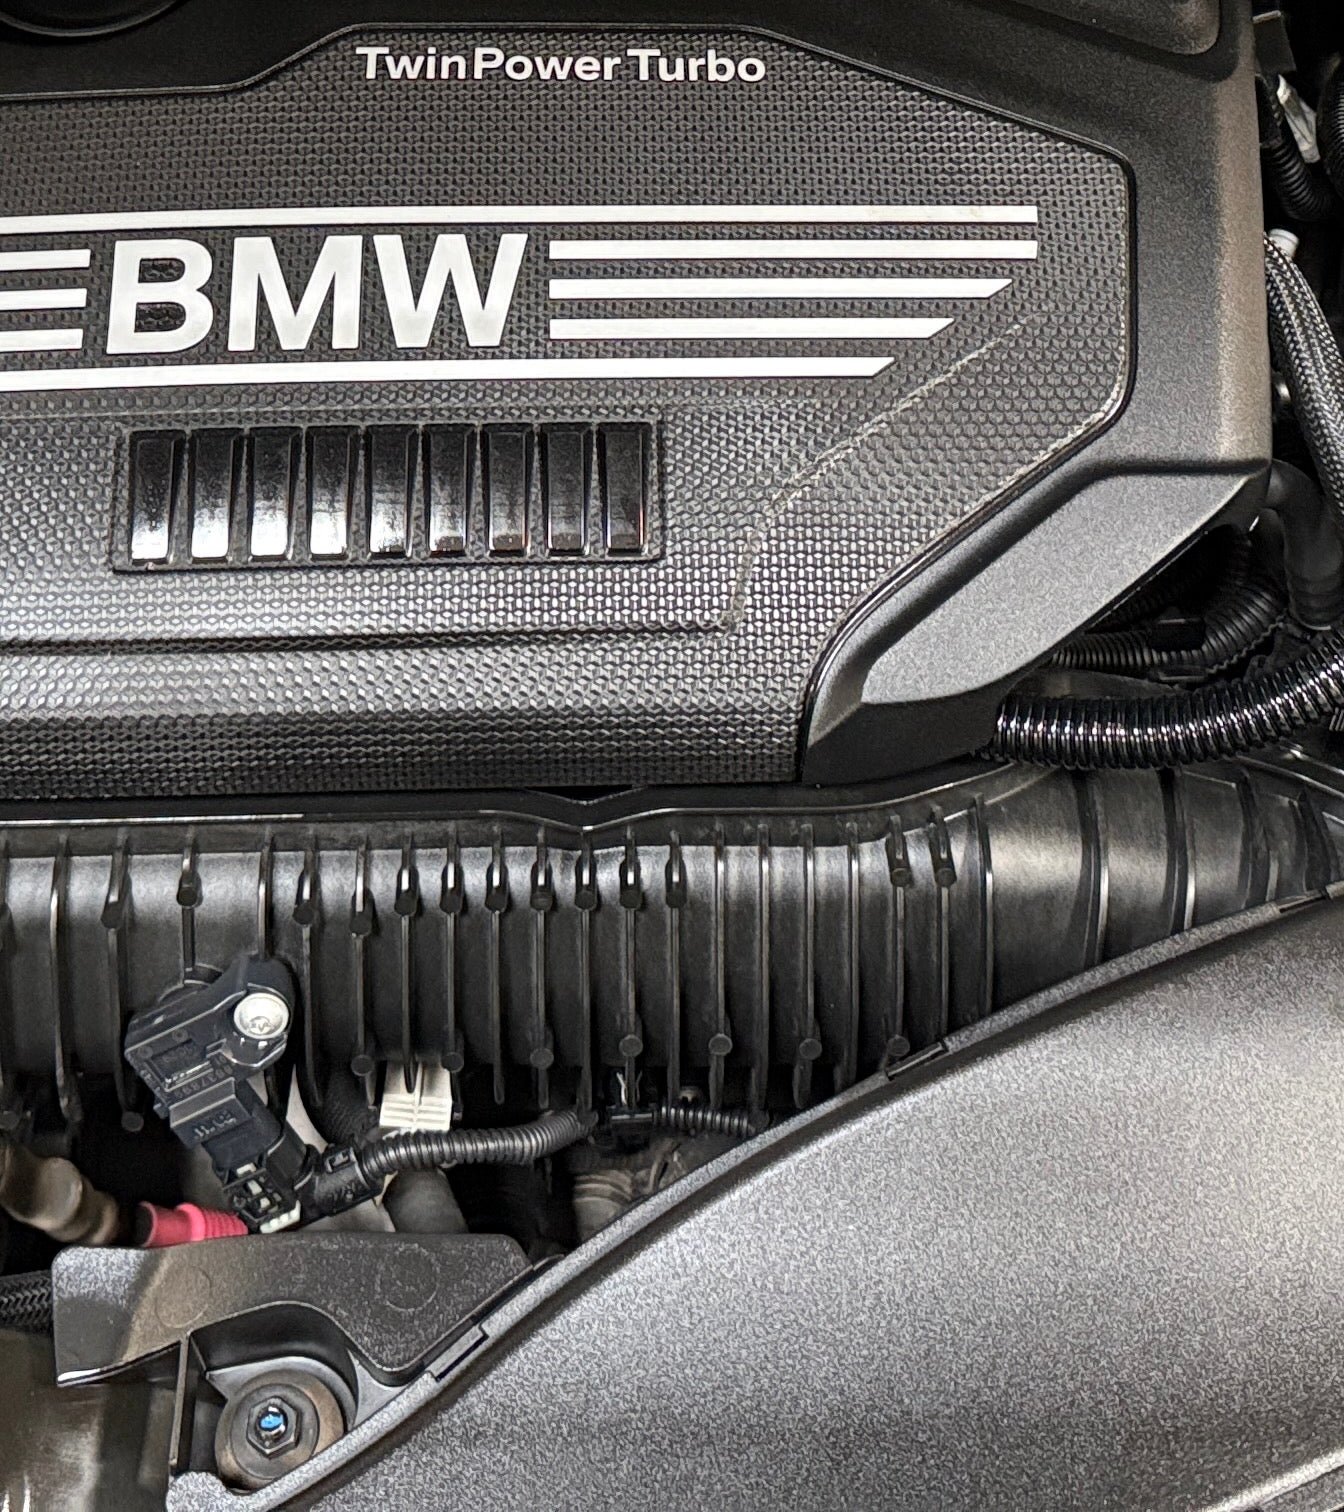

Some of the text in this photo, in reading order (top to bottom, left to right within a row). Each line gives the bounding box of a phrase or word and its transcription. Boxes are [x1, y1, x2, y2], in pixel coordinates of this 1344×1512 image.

[356, 45, 767, 83] TwinPower Turbo
[105, 233, 529, 355] BMW
